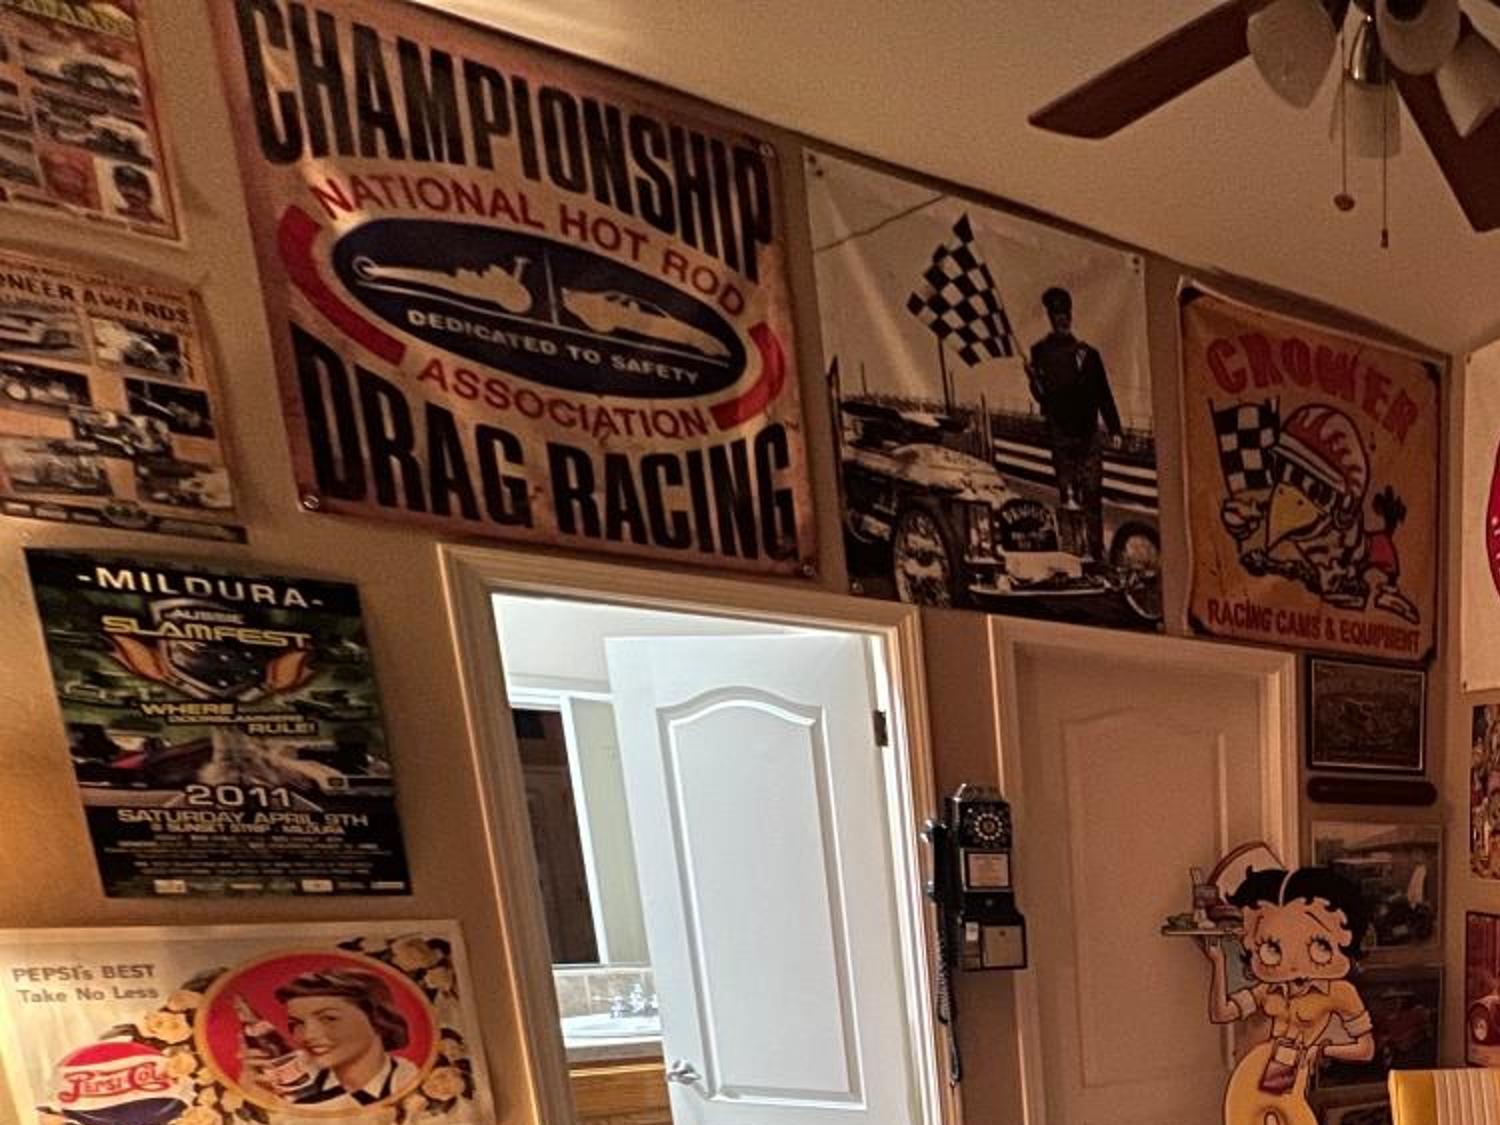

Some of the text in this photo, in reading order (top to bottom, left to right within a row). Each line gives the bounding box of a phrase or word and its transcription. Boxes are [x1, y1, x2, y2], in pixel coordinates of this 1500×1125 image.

[234, 0, 773, 285] CHAMPIONSHIP
[308, 173, 745, 316] NATIONAL HOT ROD
[83, 289, 189, 323] AWARDS
[407, 309, 699, 384] DEDICATED TO SAFETY
[416, 357, 710, 440] ASSOCIATION
[1206, 332, 1419, 443] CROWER
[290, 321, 800, 562] DRAG RACING
[102, 616, 312, 647] SLAMFEST
[1207, 598, 1420, 656] RACING CAMS & EQUIPMENT
[140, 703, 235, 716] WHERE
[117, 809, 245, 825] SATURDAY
[254, 811, 316, 826] APRIL
[185, 785, 292, 807] 2011
[16, 985, 160, 1003] Take No Less
[101, 963, 155, 979] BEST
